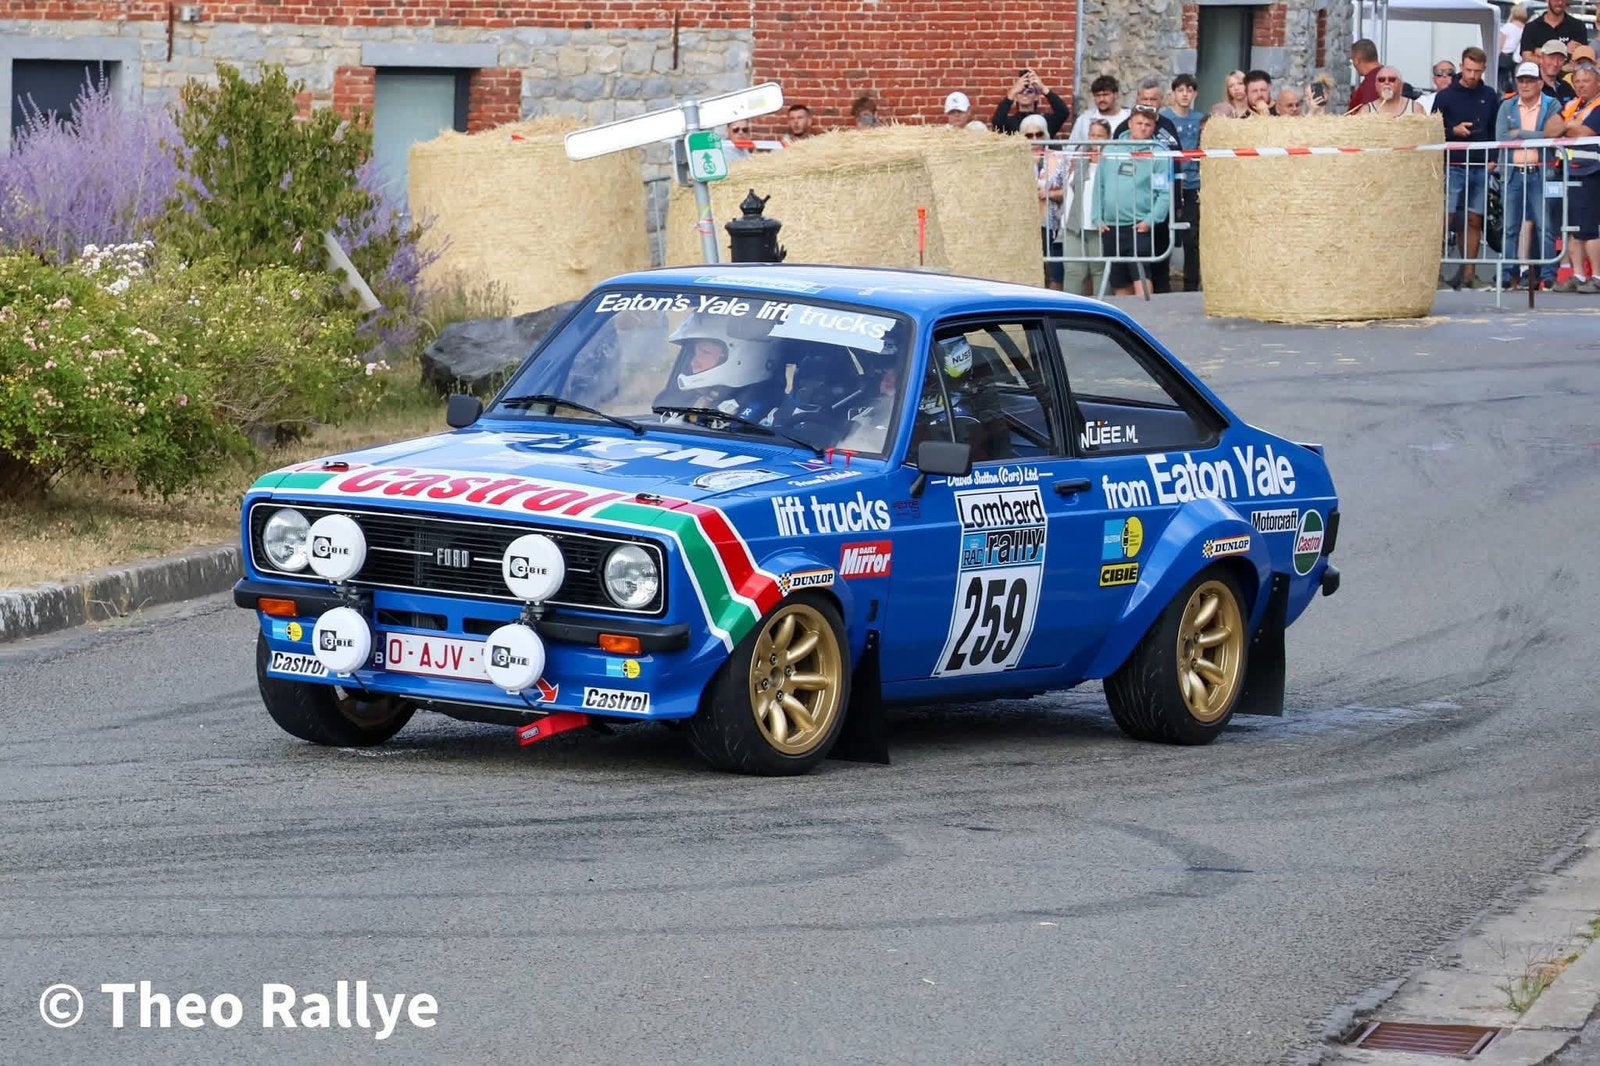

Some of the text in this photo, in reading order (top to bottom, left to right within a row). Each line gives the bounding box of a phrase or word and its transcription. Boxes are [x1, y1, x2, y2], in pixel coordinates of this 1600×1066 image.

[595, 293, 889, 338] Eaton's Yale lift trucks
[998, 465, 1022, 485] (Cars)
[1102, 445, 1296, 510] from Eaton Yale
[337, 468, 625, 517] Castrol
[772, 496, 810, 536] lift
[811, 491, 891, 534] trucks
[957, 490, 1044, 529] Lombard
[1252, 511, 1298, 532] Motorcraft
[437, 548, 470, 568] FORD
[859, 546, 877, 554] DAILY
[963, 530, 1044, 566] RAC rally
[1214, 539, 1249, 553] DUNLOP
[839, 548, 891, 575] Mirror
[792, 573, 833, 587] DUNLOP
[945, 576, 1028, 671] 259
[374, 652, 384, 664] B
[389, 639, 484, 672] O-AJV-
[585, 689, 648, 712] Castrol
